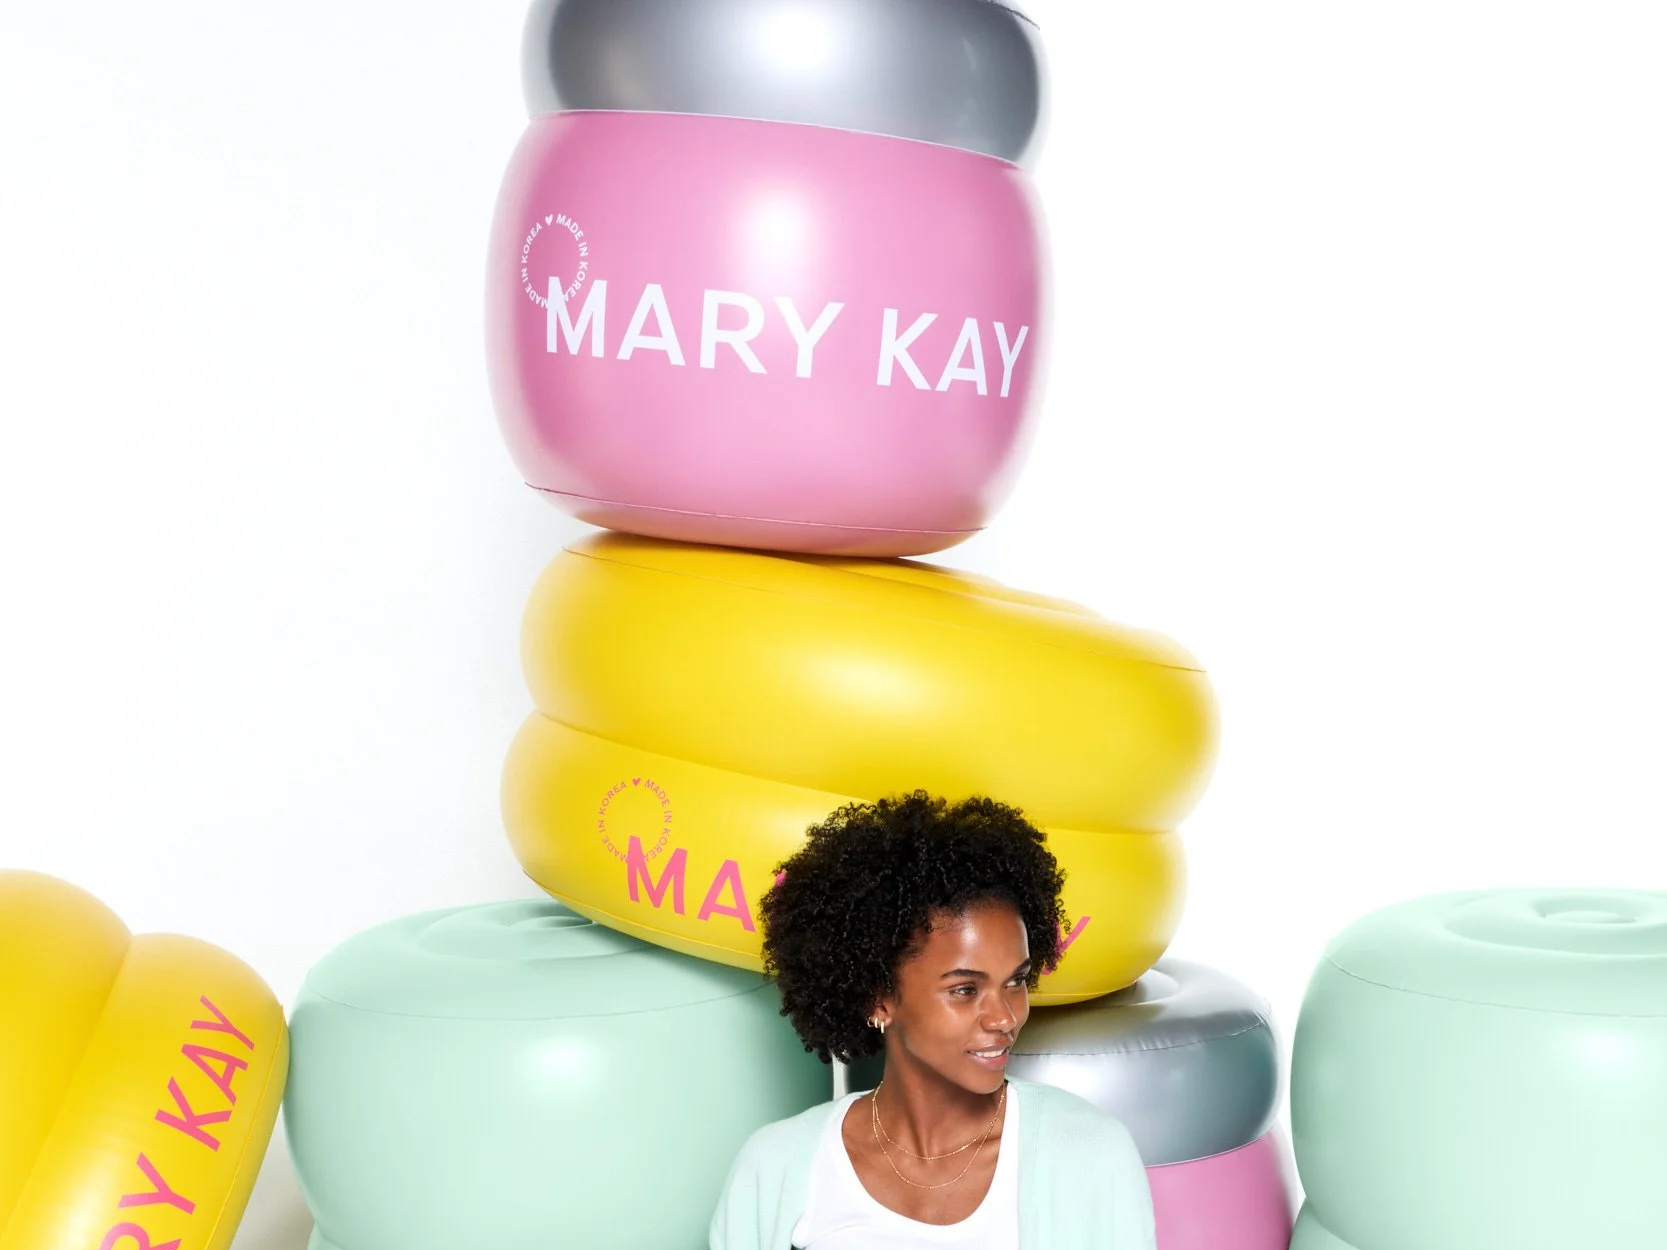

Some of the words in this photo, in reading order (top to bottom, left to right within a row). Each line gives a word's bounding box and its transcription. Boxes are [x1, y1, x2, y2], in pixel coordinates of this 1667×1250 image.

[556, 213, 584, 241] MADE
[521, 222, 543, 264] KOREA
[578, 241, 589, 257] IN
[521, 267, 529, 282] IN
[563, 261, 588, 302] KOREA
[525, 282, 548, 309] MADE
[546, 275, 845, 379] MARY
[876, 307, 1029, 398] KAY
[598, 781, 627, 815] KOREA
[644, 779, 670, 807] MADE
[598, 820, 606, 833] IN
[663, 810, 672, 823] IN
[626, 834, 786, 933] MA
[154, 995, 254, 1152] KAY
